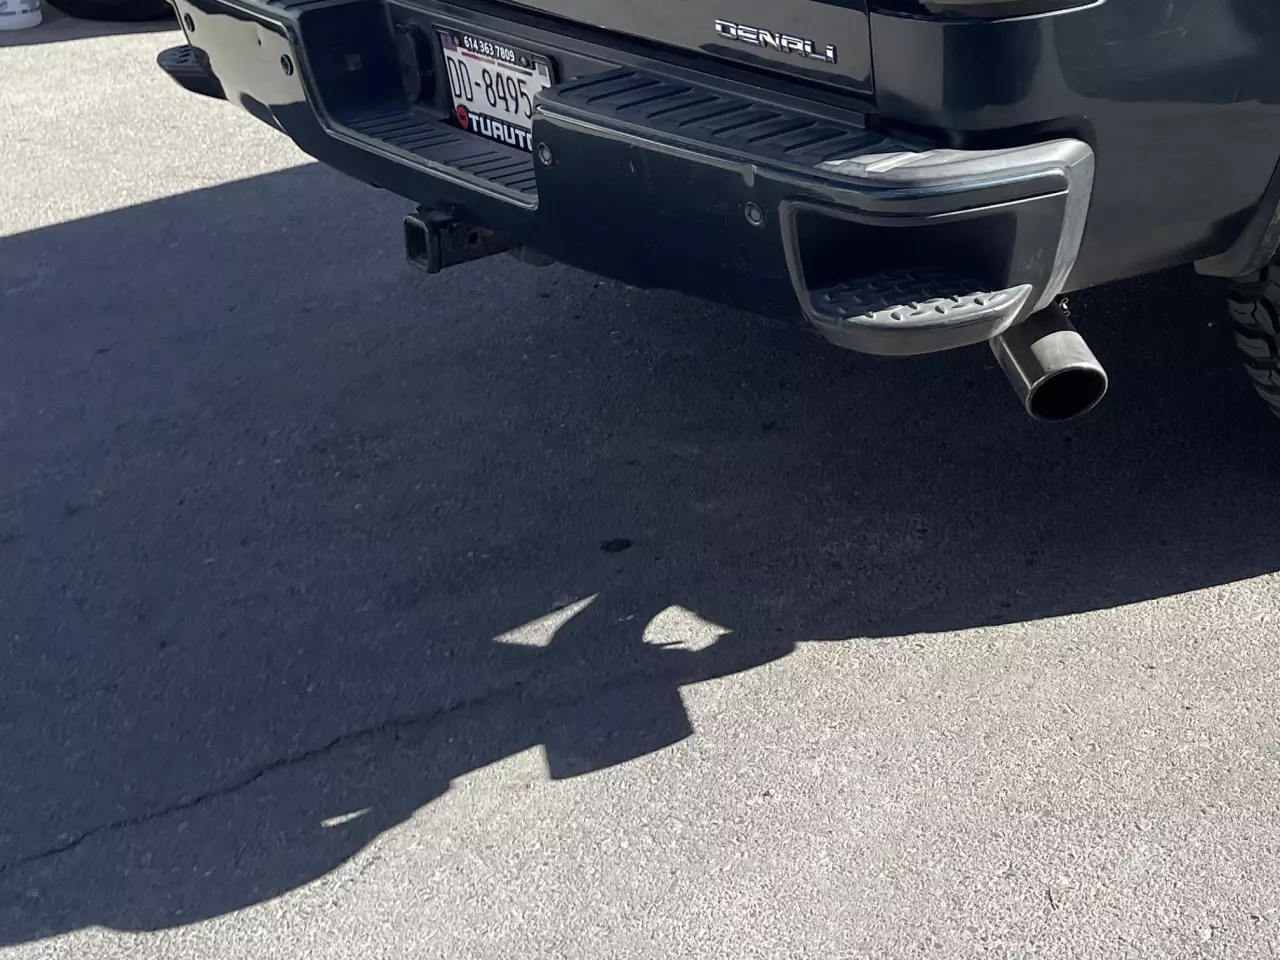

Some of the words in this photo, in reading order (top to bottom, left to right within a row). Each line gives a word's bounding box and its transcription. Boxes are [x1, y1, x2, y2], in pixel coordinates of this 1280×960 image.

[463, 35, 479, 52] 614
[479, 40, 494, 57] 363
[494, 45, 516, 62] 7809
[714, 18, 838, 64] DENALI
